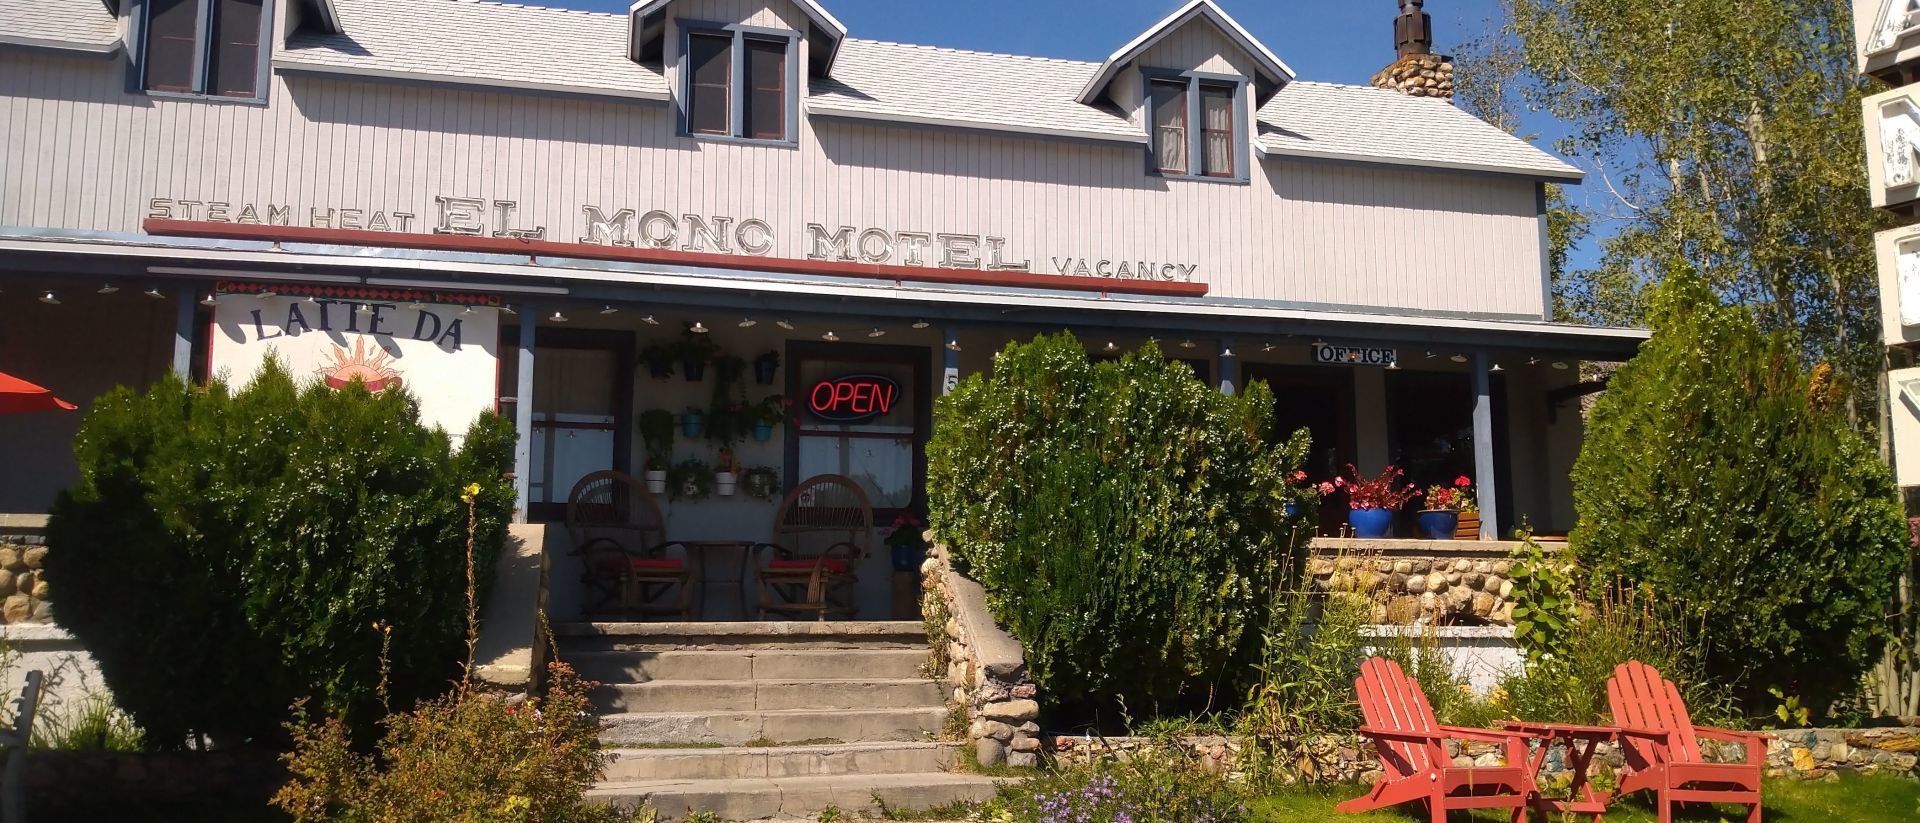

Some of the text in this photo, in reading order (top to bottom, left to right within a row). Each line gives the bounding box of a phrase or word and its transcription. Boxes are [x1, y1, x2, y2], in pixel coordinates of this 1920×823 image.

[149, 195, 1198, 282] STEAM HEAT EL MONO MOTEL VACANCY
[250, 299, 463, 351] LATTE DA
[1320, 346, 1394, 363] OFFICE
[811, 381, 892, 413] OPEN
